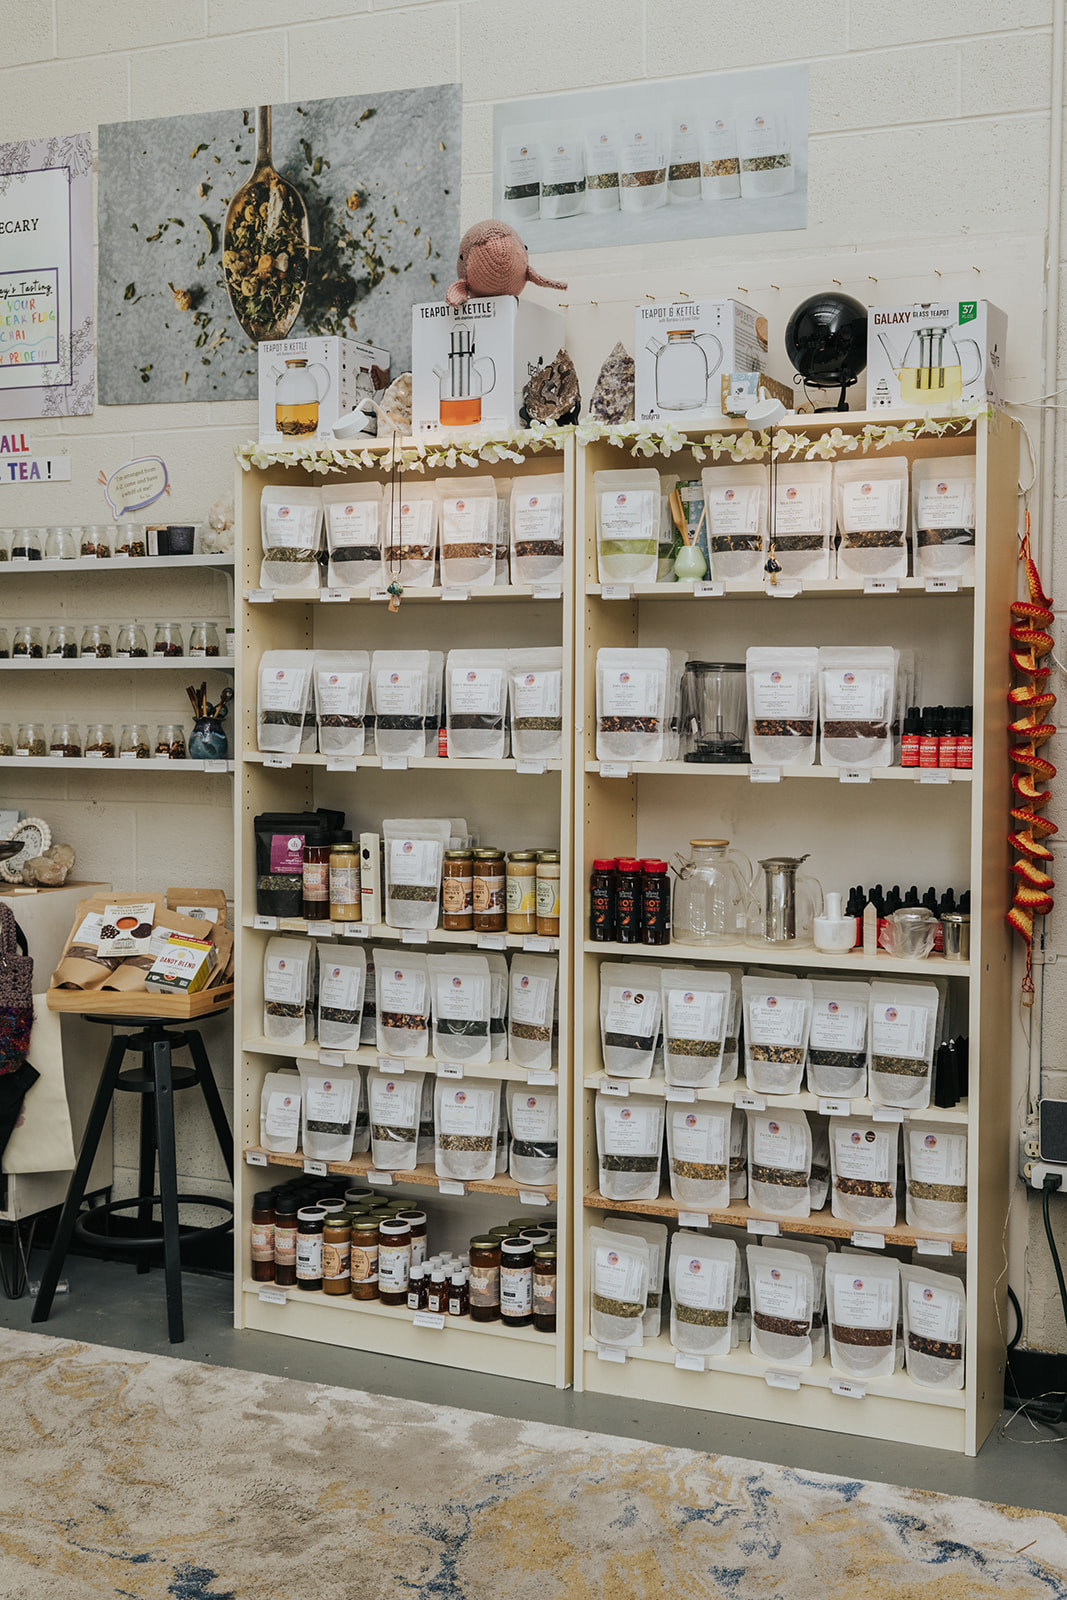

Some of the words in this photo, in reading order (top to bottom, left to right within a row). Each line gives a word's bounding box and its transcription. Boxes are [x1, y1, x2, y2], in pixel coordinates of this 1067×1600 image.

[7, 298, 36, 313] YOUR
[421, 306, 450, 318] TEAPOT
[462, 302, 491, 315] KETTLE
[642, 308, 666, 319] TEAPOT
[677, 305, 700, 316] KETTLE
[32, 310, 55, 324] FLAG
[874, 311, 911, 325] GALAXY
[913, 310, 930, 318] GLASS
[930, 309, 949, 317] TEAPOT
[962, 304, 974, 314] 37
[0, 330, 26, 342] CHAI
[263, 343, 282, 352] TEAPOT
[289, 341, 308, 351] KETTLE
[0, 433, 30, 453] ALL
[592, 897, 609, 905] HOT
[617, 899, 634, 907] HOT
[644, 899, 661, 907] HOT
[160, 956, 178, 965] DANDY
[178, 960, 196, 969] BLEND
